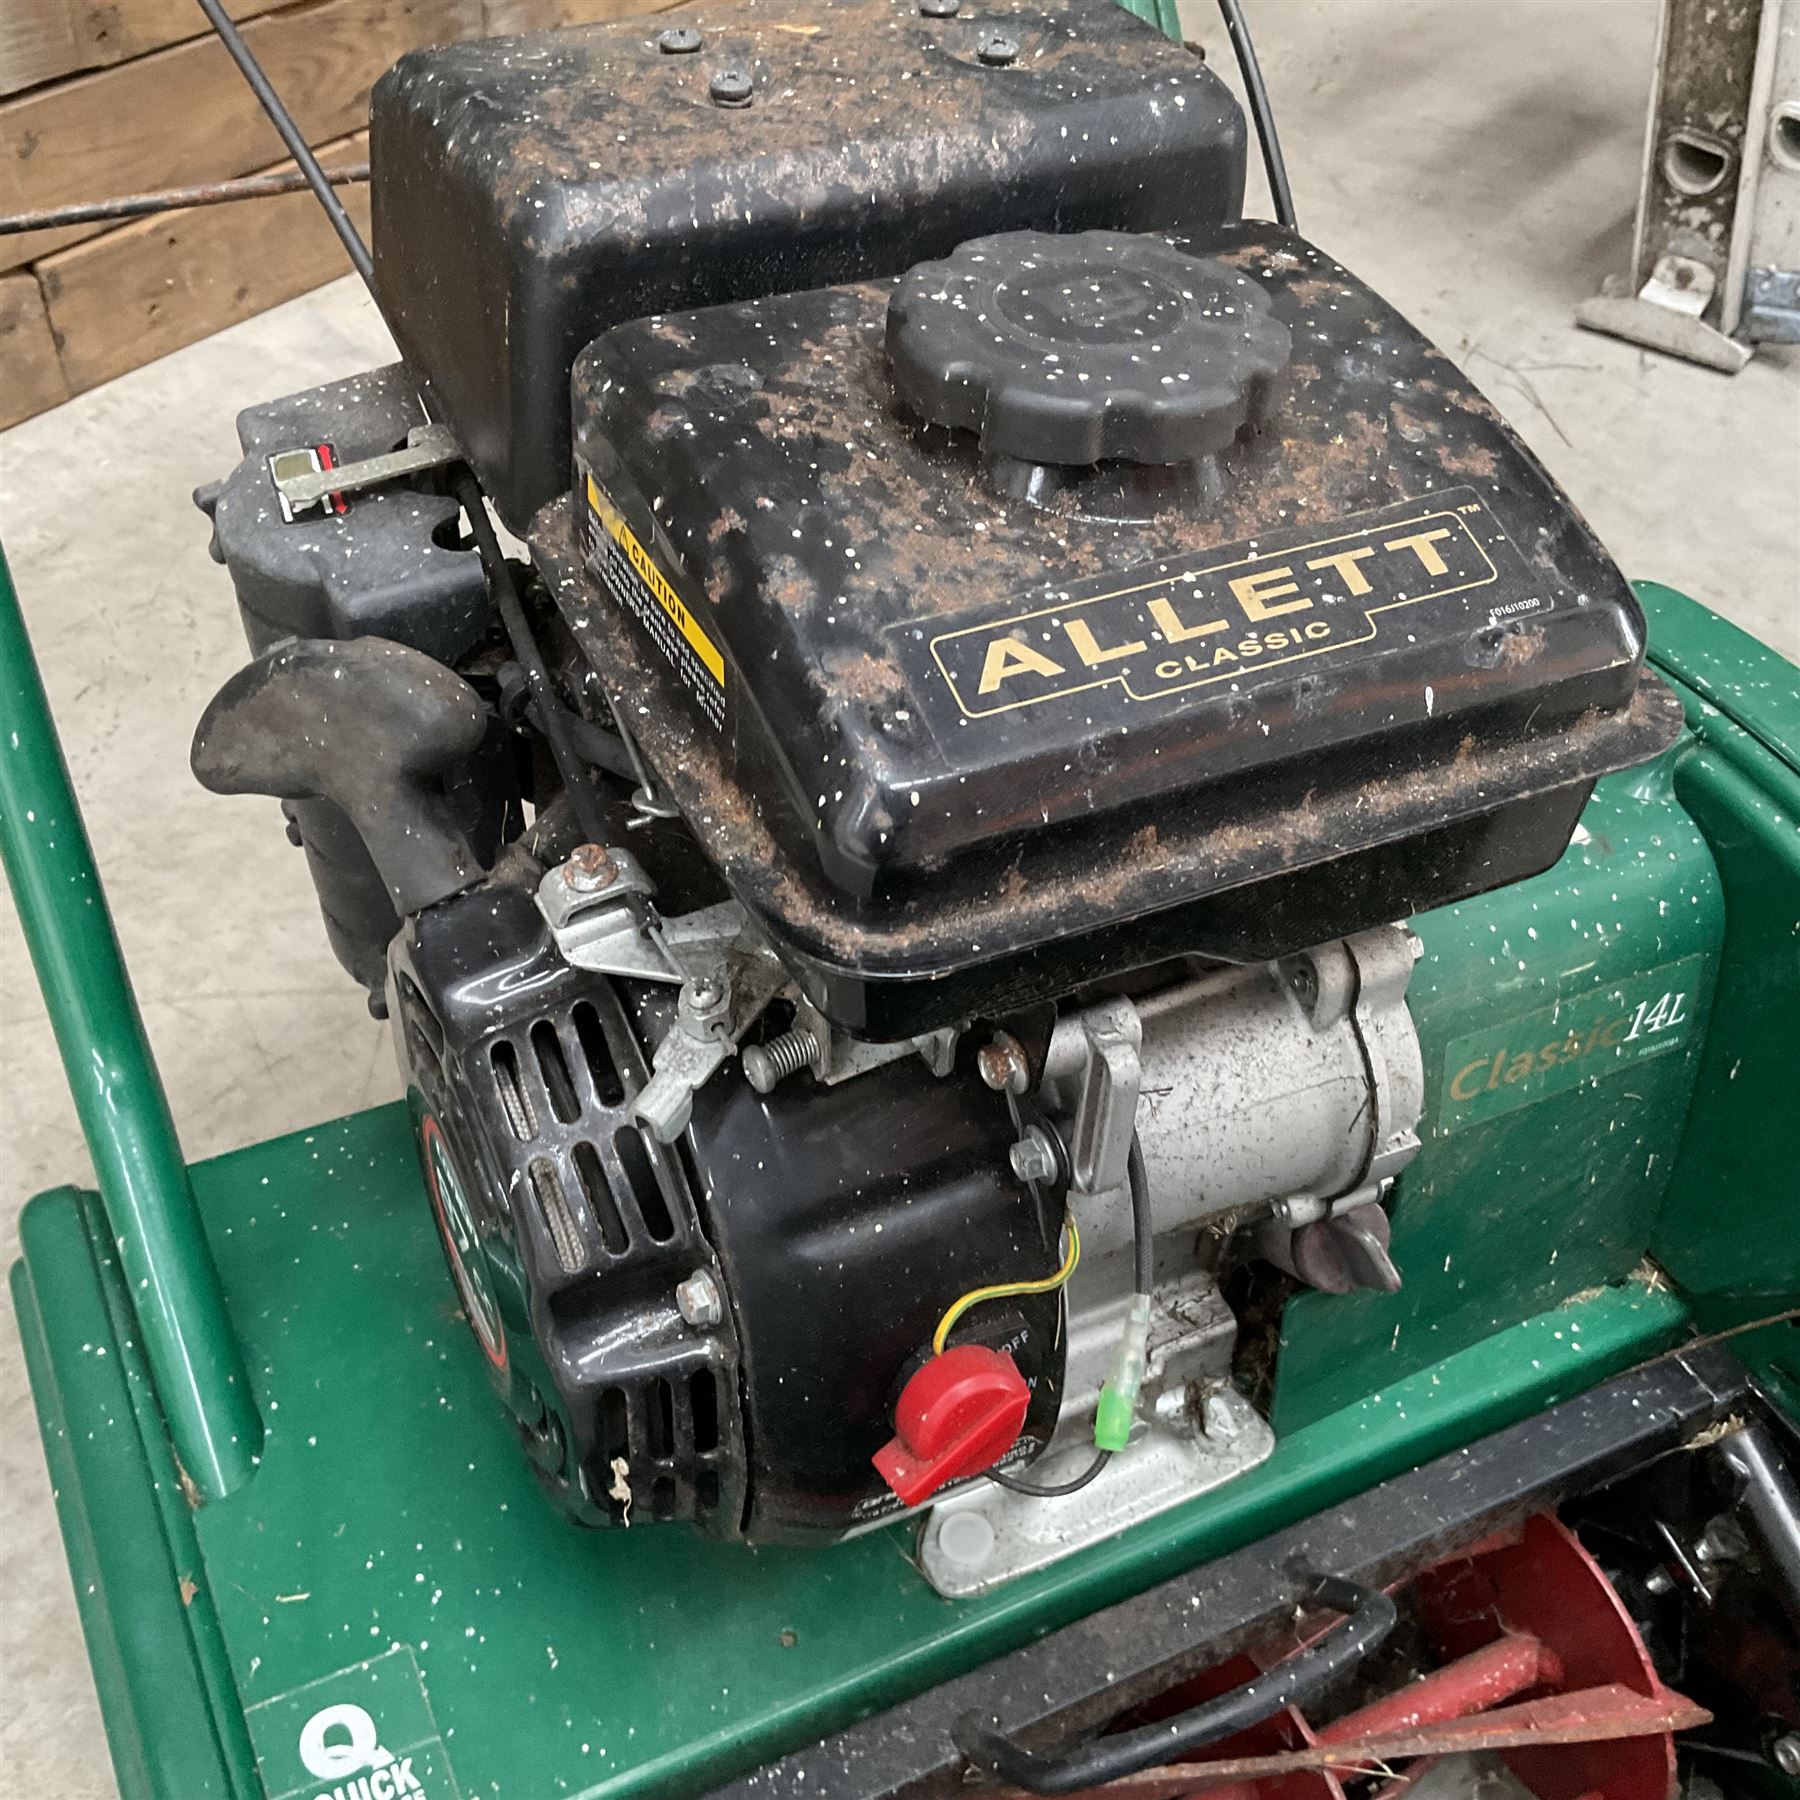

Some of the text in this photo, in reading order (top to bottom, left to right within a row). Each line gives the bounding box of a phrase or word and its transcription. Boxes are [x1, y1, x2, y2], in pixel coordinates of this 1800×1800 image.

[632, 543, 685, 629] CAUTION
[976, 527, 1452, 695] ALLETT
[642, 615, 676, 668] MANUAL
[680, 668, 691, 689] for
[651, 600, 665, 627] sure
[668, 622, 675, 638] to
[691, 656, 726, 708] specified
[1154, 619, 1332, 680] CLASSIC
[680, 656, 706, 695] please
[706, 692, 725, 721] refer
[1623, 991, 1687, 1043] 14L
[1450, 1015, 1629, 1101] Classic
[299, 1703, 396, 1780] Q
